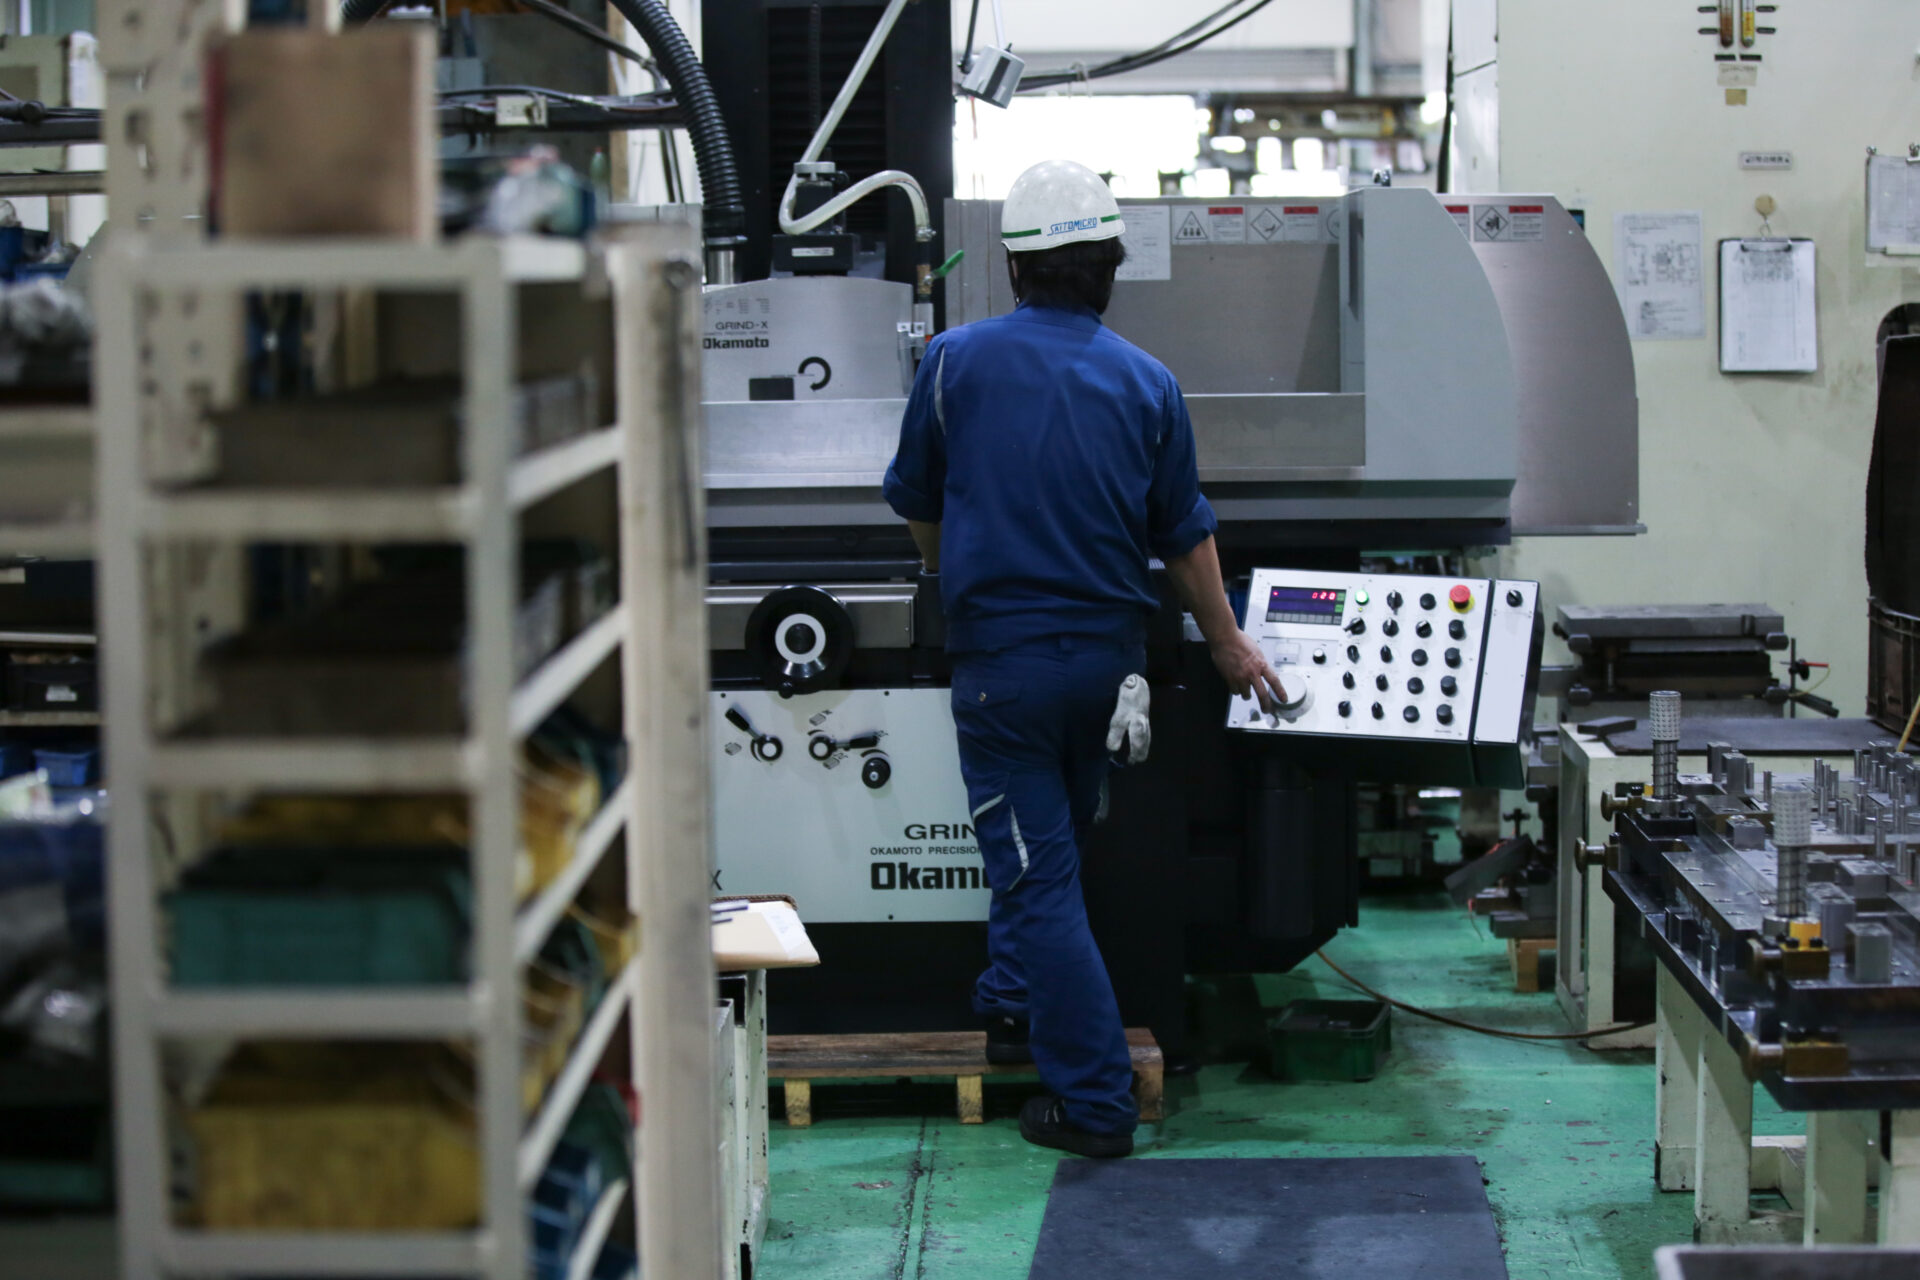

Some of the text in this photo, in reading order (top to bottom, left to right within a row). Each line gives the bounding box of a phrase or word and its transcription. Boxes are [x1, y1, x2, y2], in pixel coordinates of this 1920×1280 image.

[703, 337, 769, 349] Okamoto
[870, 846, 981, 856] OKAMOTO PRECISIO
